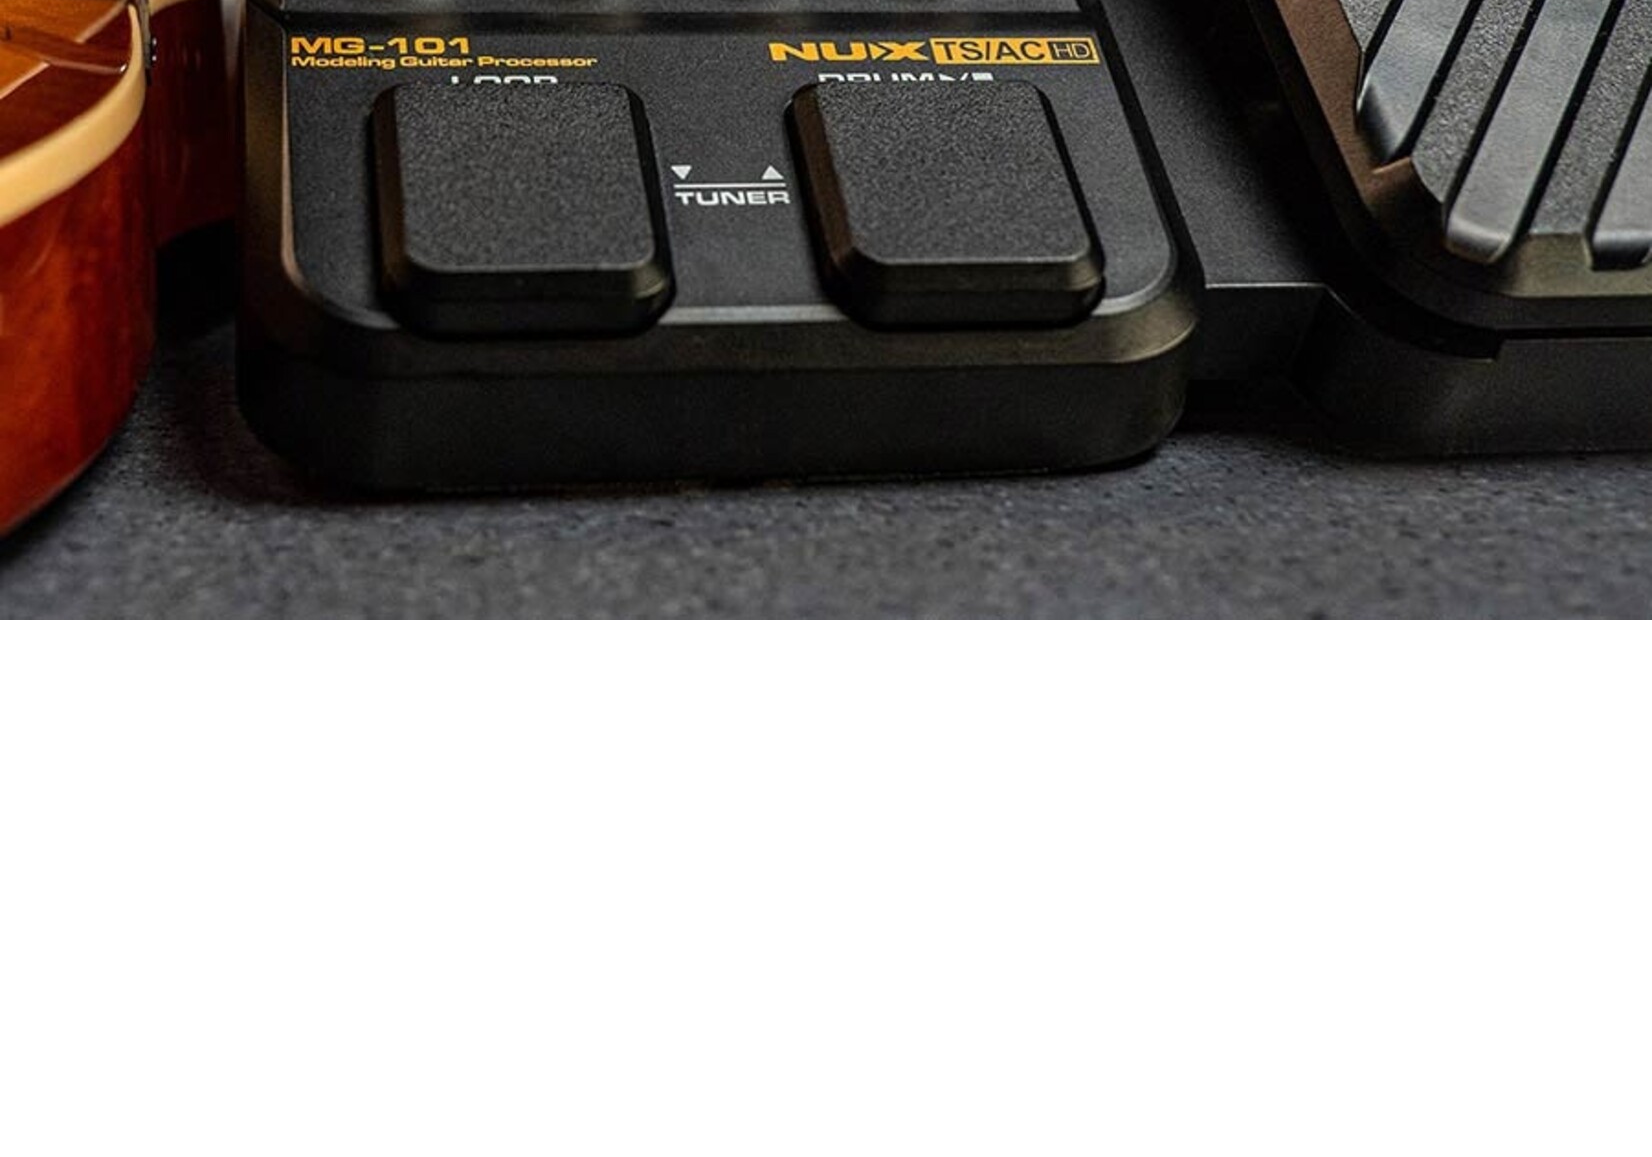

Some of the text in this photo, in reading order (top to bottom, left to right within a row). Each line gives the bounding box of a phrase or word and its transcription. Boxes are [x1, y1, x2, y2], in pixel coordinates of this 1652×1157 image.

[291, 37, 470, 54] MG-101
[768, 41, 930, 62] NUX
[1053, 43, 1091, 59] HD
[291, 55, 599, 70] Modeling Guitar Processor
[674, 190, 791, 206] TUNER
